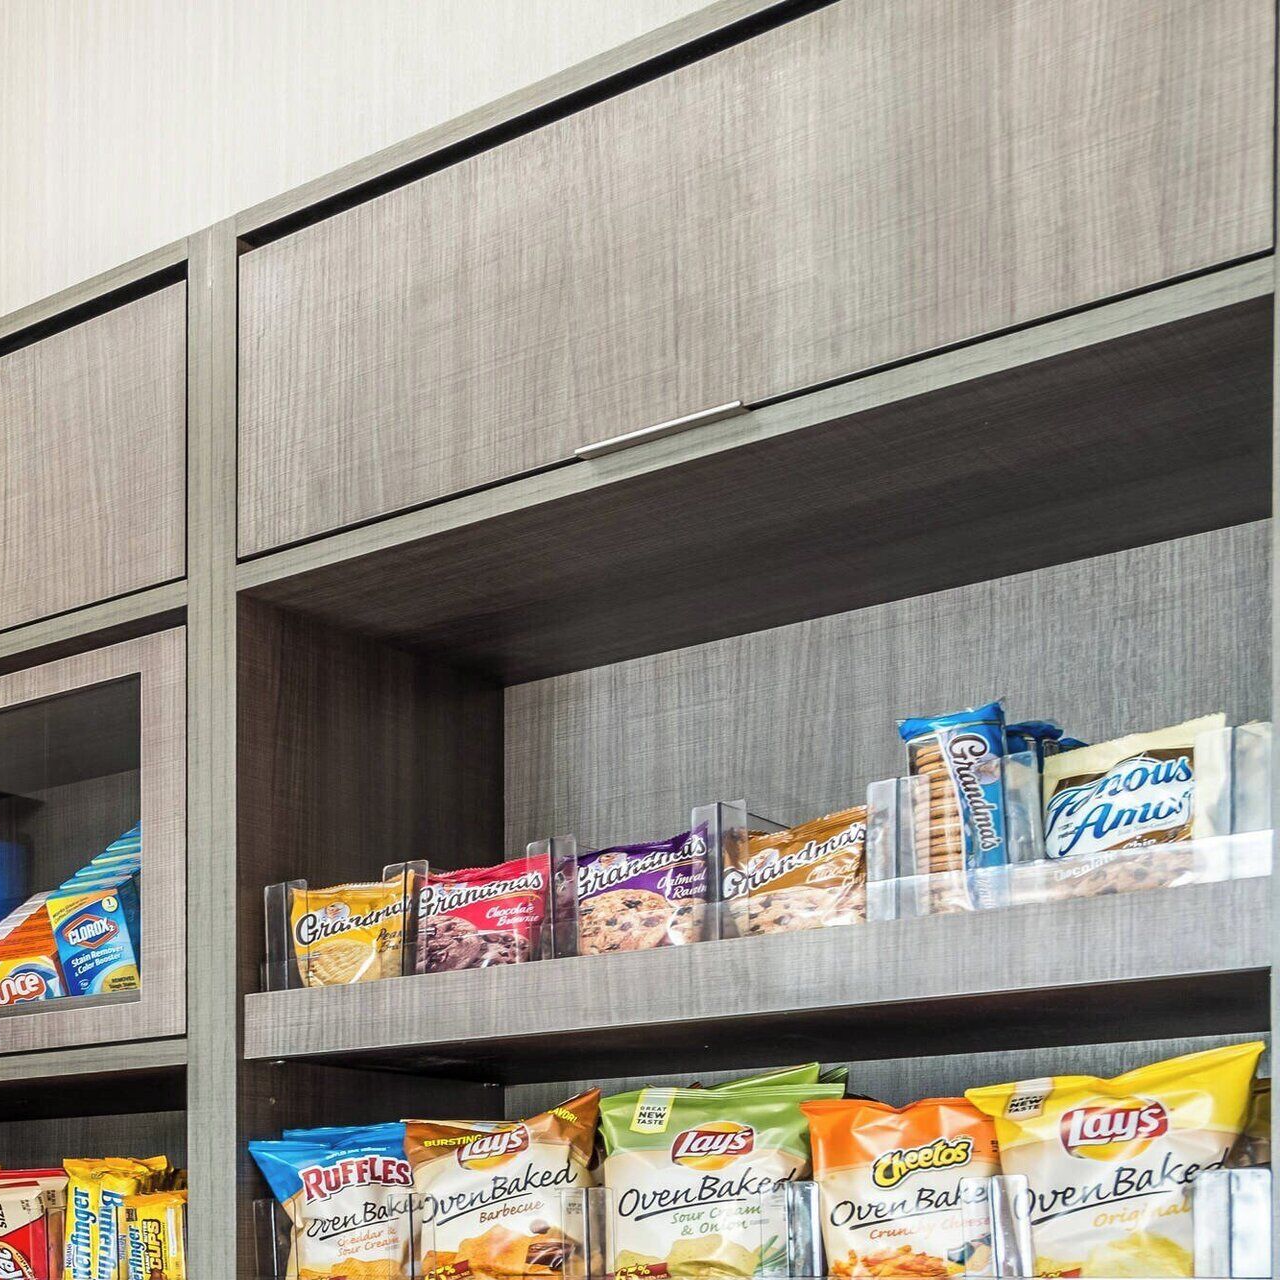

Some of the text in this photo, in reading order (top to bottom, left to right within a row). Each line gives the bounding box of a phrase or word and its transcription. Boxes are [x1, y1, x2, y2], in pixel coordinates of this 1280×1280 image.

[948, 734, 1002, 851] Grandma's
[576, 834, 707, 900] Grandma's
[657, 868, 706, 891] Oatmeal
[672, 882, 708, 900] Raisin
[419, 870, 544, 918] Grandma's
[486, 904, 536, 920] Chocolate
[497, 913, 541, 928] Brownie
[68, 918, 110, 945] CLOROX
[71, 952, 92, 968] Stain
[77, 962, 95, 976] Color
[1007, 1105, 1042, 1114] TASTE
[1009, 1098, 1044, 1109] NEW
[636, 1118, 665, 1127] TASTE
[637, 1111, 667, 1120] NEW
[873, 1138, 973, 1187] Cheetos
[301, 1156, 413, 1200] RUFFLES
[489, 1161, 579, 1200] Baked
[618, 1168, 800, 1218] Oven Baked
[479, 1200, 545, 1223] Barbecue
[671, 1209, 707, 1225] Sour
[830, 1198, 906, 1227] Oven
[306, 1210, 359, 1238] Oven
[680, 1225, 694, 1237] &
[147, 1218, 164, 1271] CUPS
